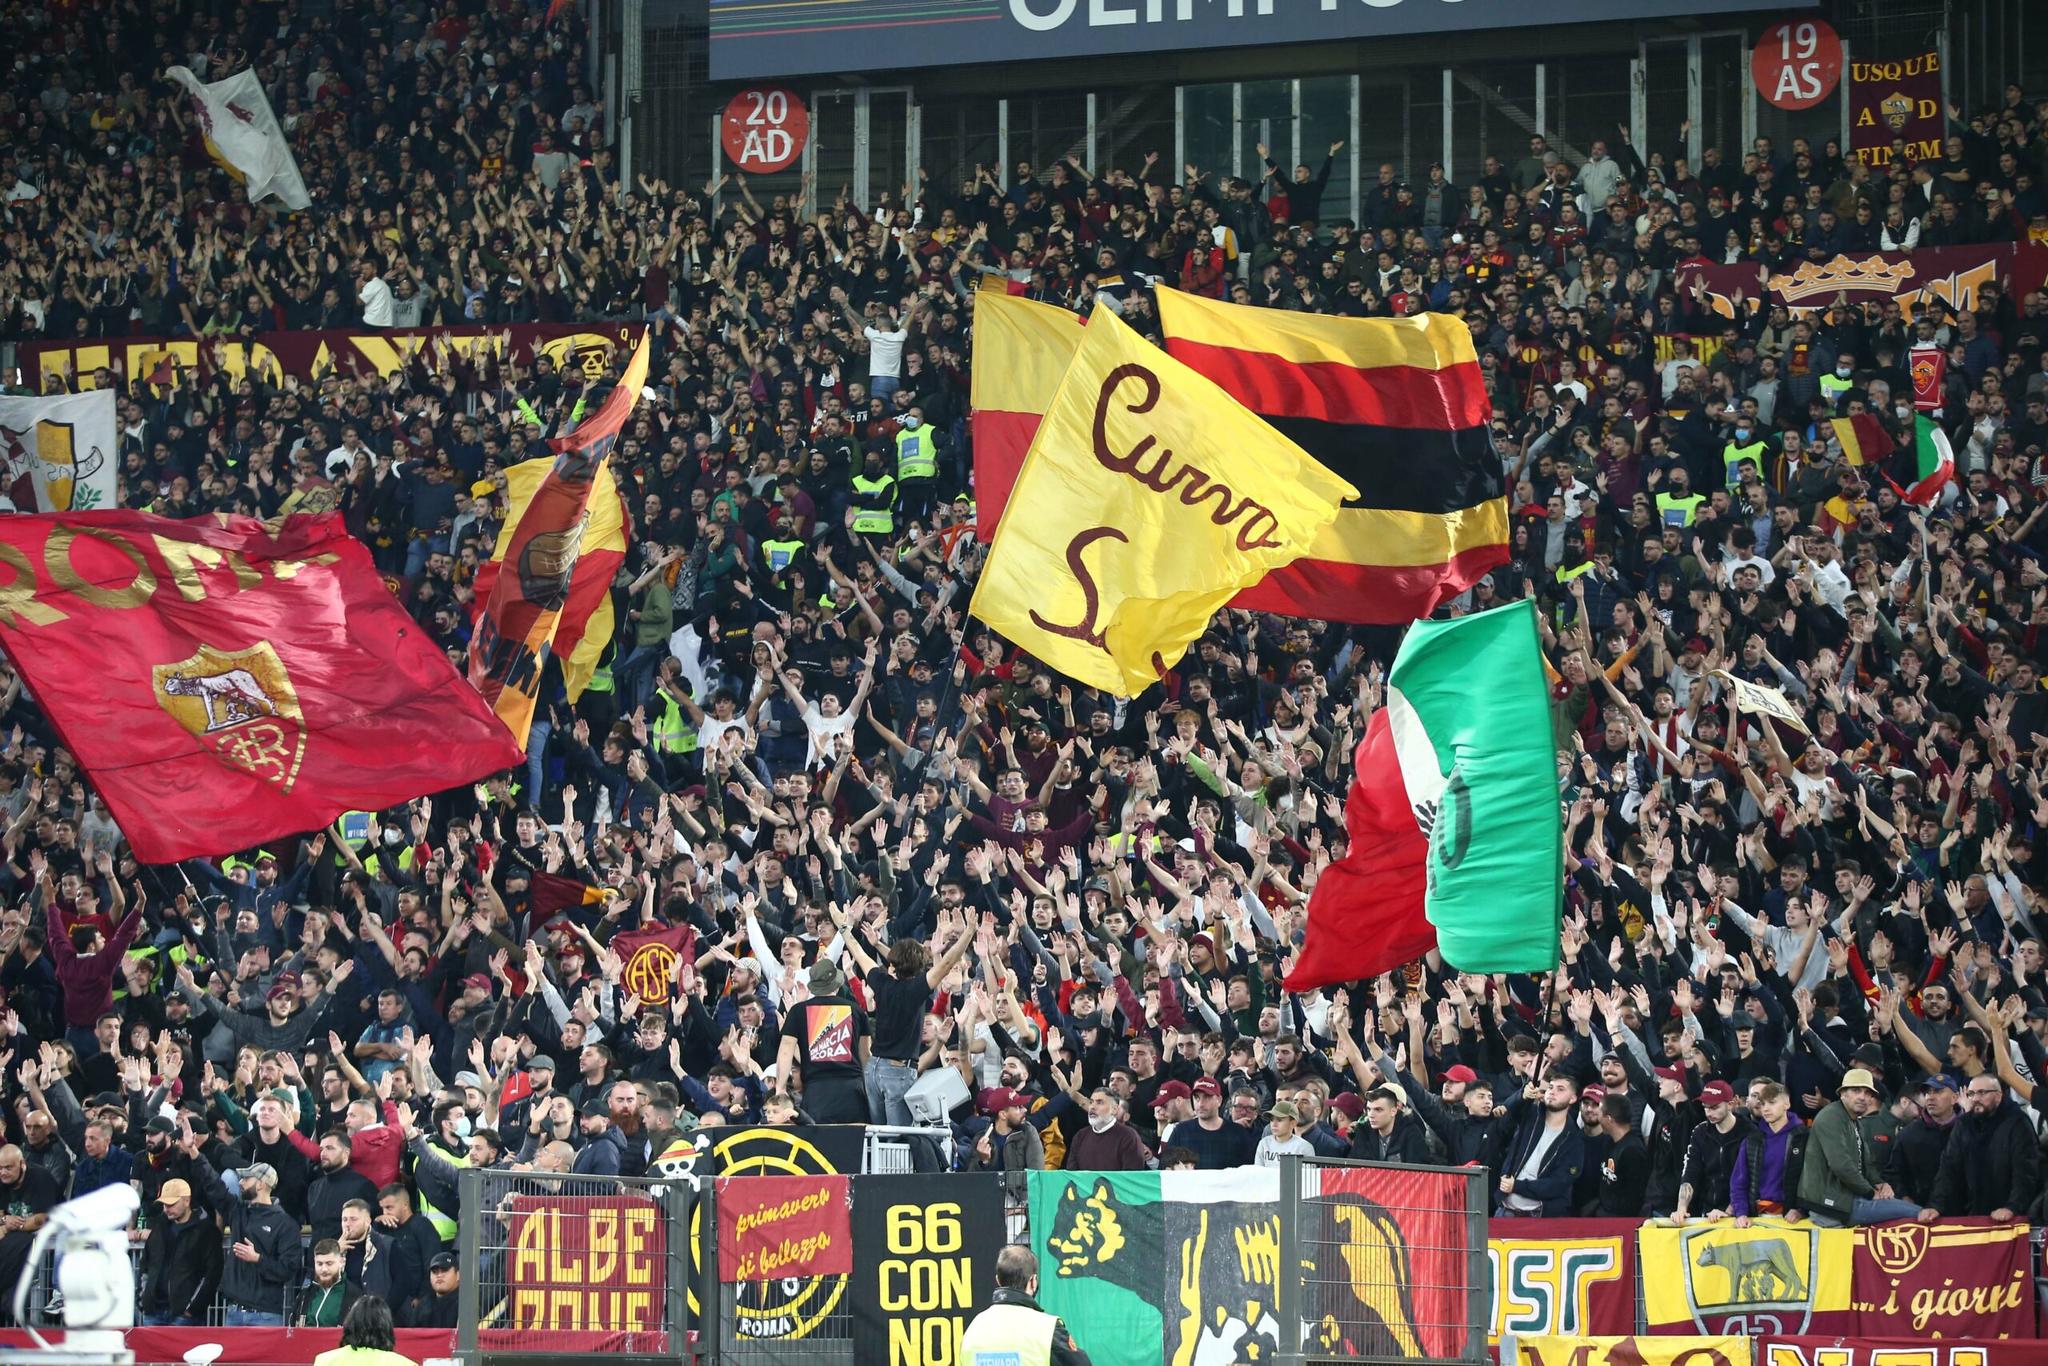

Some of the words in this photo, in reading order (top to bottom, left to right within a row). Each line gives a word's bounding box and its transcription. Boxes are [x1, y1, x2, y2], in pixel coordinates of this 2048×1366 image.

[1776, 23, 1817, 60] 19
[1852, 52, 1940, 82] USQUE
[1774, 63, 1822, 101] AS
[746, 91, 787, 125] 20
[739, 129, 791, 164] AD
[1092, 363, 1282, 552] Curva
[735, 1187, 831, 1243] primavera
[886, 1202, 962, 1255] 66
[514, 1206, 656, 1284] ALBE
[736, 1251, 756, 1281] di
[759, 1230, 831, 1275] bellezza
[878, 1257, 973, 1312] CON
